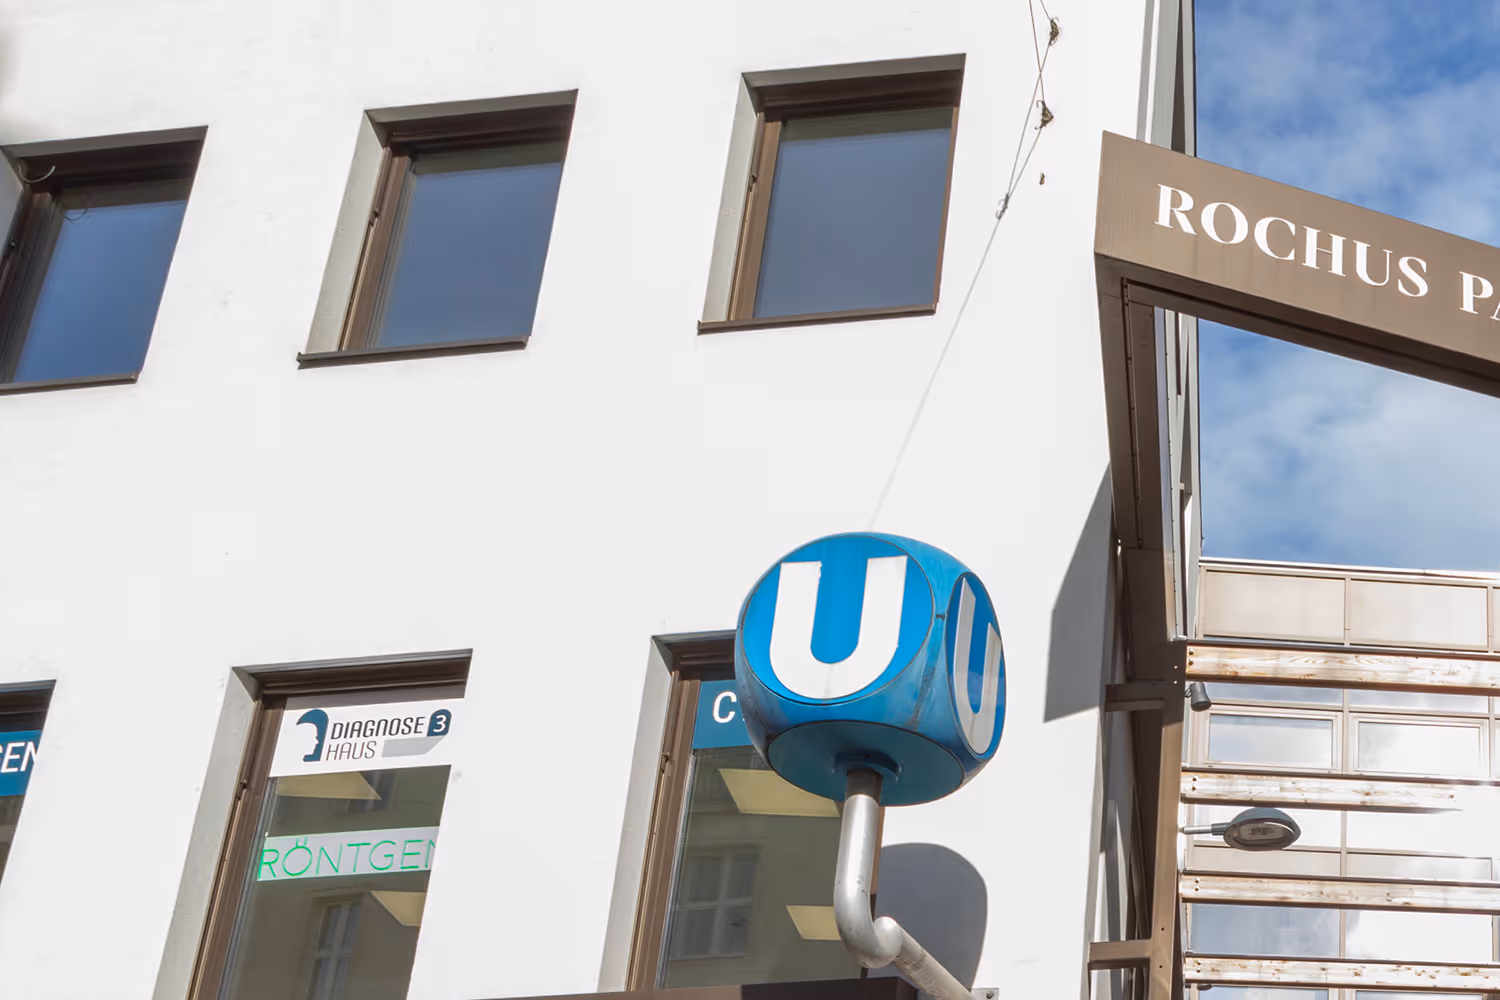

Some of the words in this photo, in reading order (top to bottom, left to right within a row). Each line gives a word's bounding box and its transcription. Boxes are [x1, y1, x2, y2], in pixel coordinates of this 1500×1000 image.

[1154, 182, 1429, 298] ROCHUS
[769, 556, 907, 699] U
[952, 577, 1002, 754] U
[326, 741, 377, 761] HAUS
[330, 717, 426, 740] DIAGNOSE
[433, 714, 447, 734] 3
